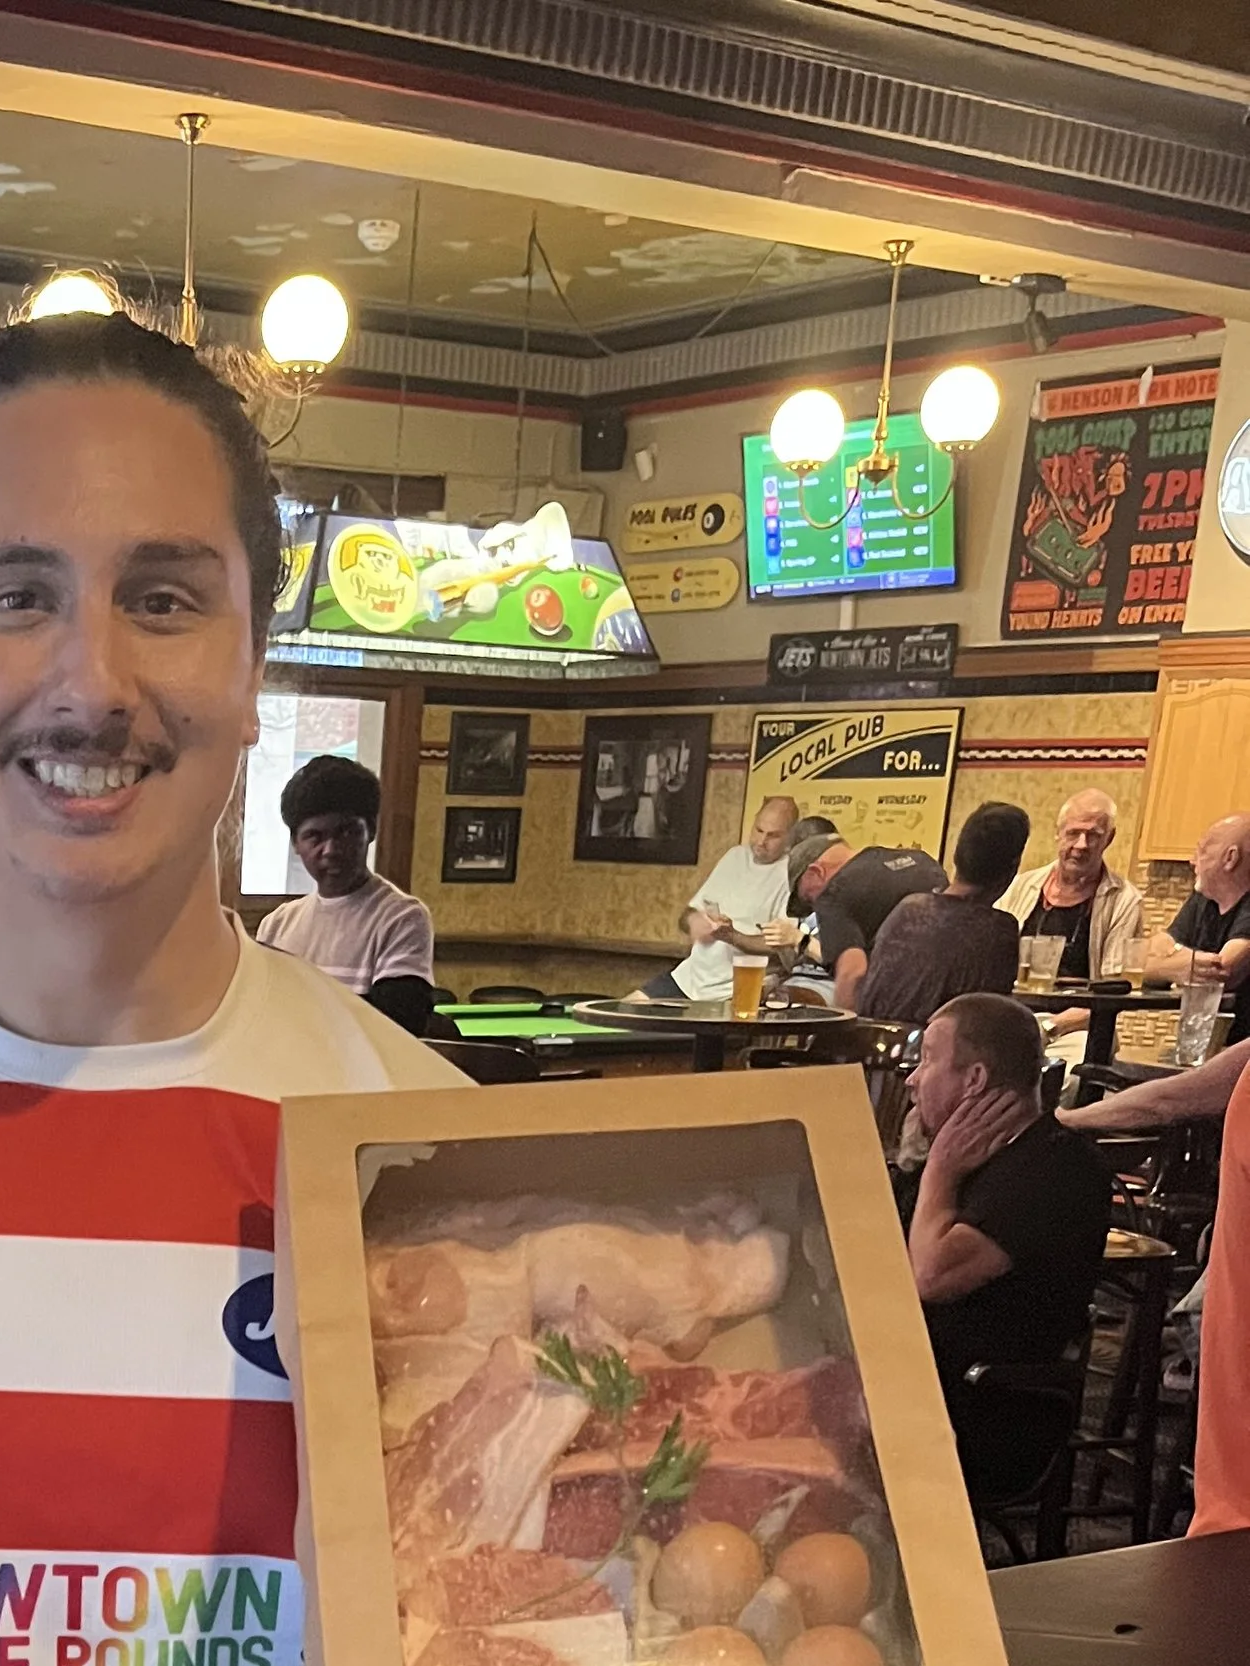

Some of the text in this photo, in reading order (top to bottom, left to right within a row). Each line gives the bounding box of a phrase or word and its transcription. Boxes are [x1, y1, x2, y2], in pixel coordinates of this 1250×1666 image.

[1061, 386, 1123, 411] HENSON
[1127, 380, 1170, 404] PRK
[1130, 543, 1173, 565] FREE
[778, 647, 815, 668] JETS
[762, 722, 795, 737] YOUR
[780, 715, 884, 782] LOCAL PUB
